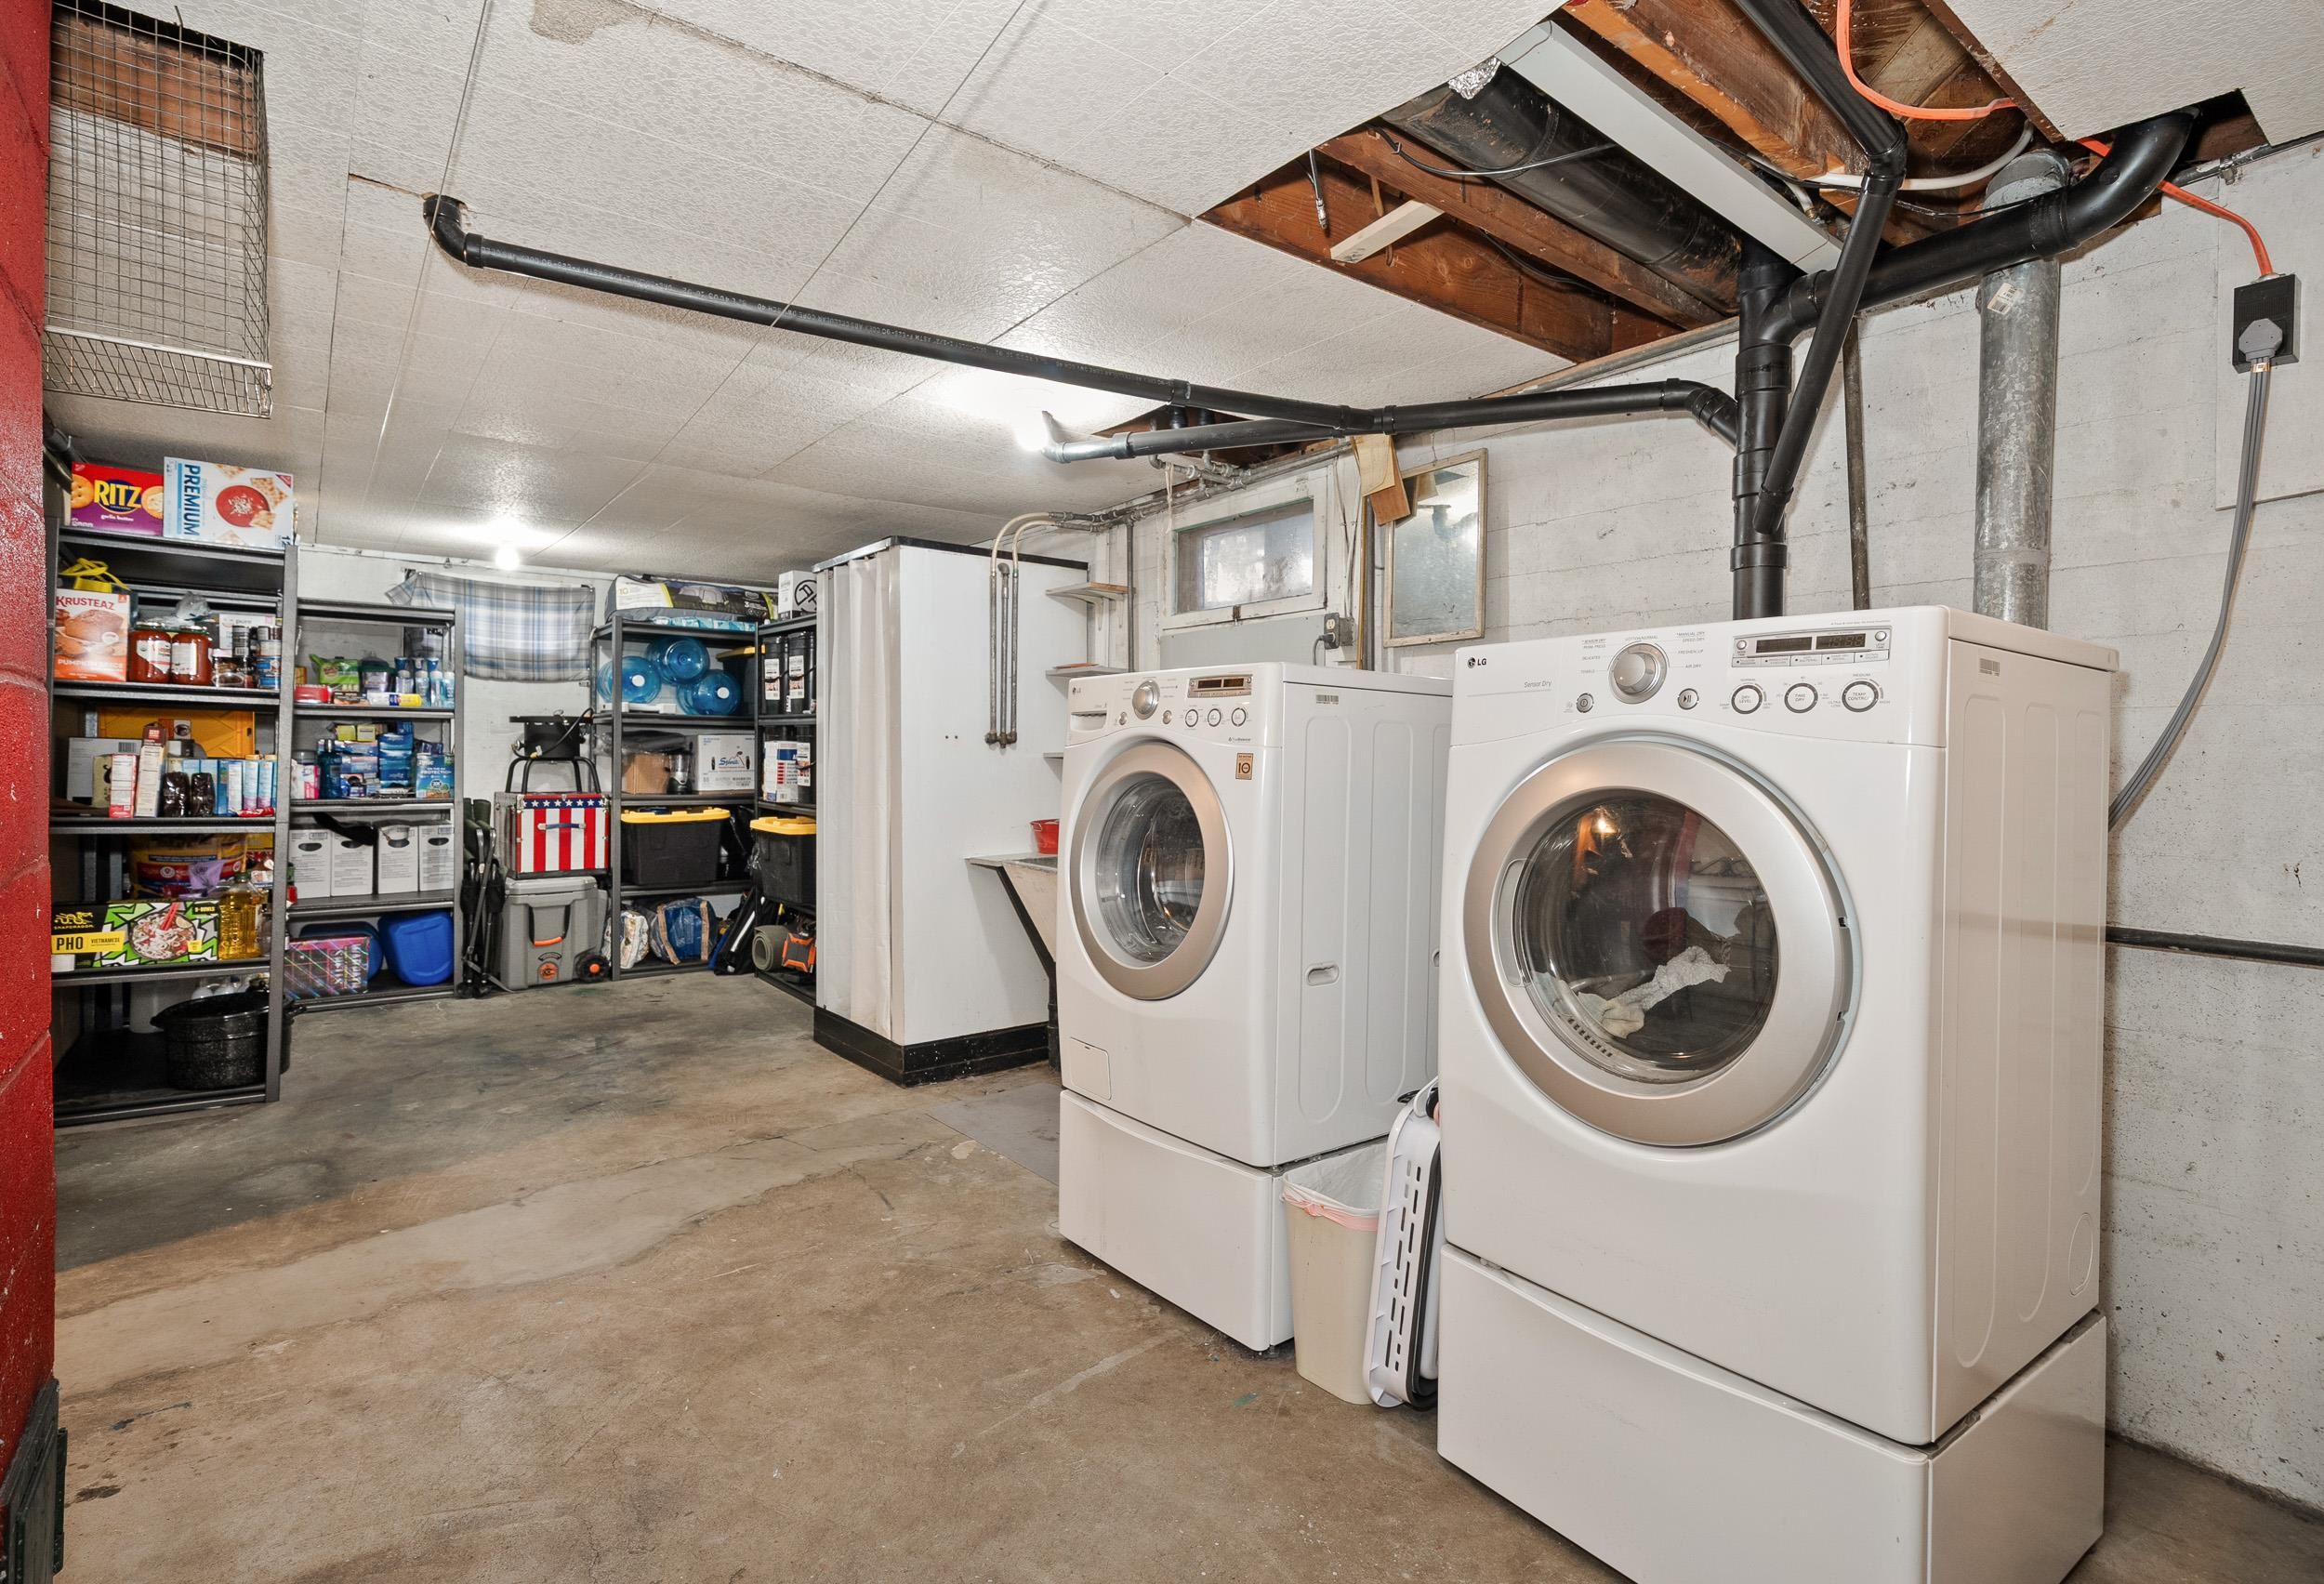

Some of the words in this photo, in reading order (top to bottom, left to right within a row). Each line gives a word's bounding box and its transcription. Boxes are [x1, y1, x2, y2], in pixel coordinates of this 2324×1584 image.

[796, 310, 816, 321] CORE
[815, 315, 850, 328] CELLULAR
[94, 479, 142, 508] RITZ
[183, 464, 201, 536] PREMIUM
[56, 596, 114, 610] KRUSTEAZ
[1477, 658, 1487, 667] LG
[1541, 680, 1552, 688] Dry
[57, 936, 84, 951] PHO
